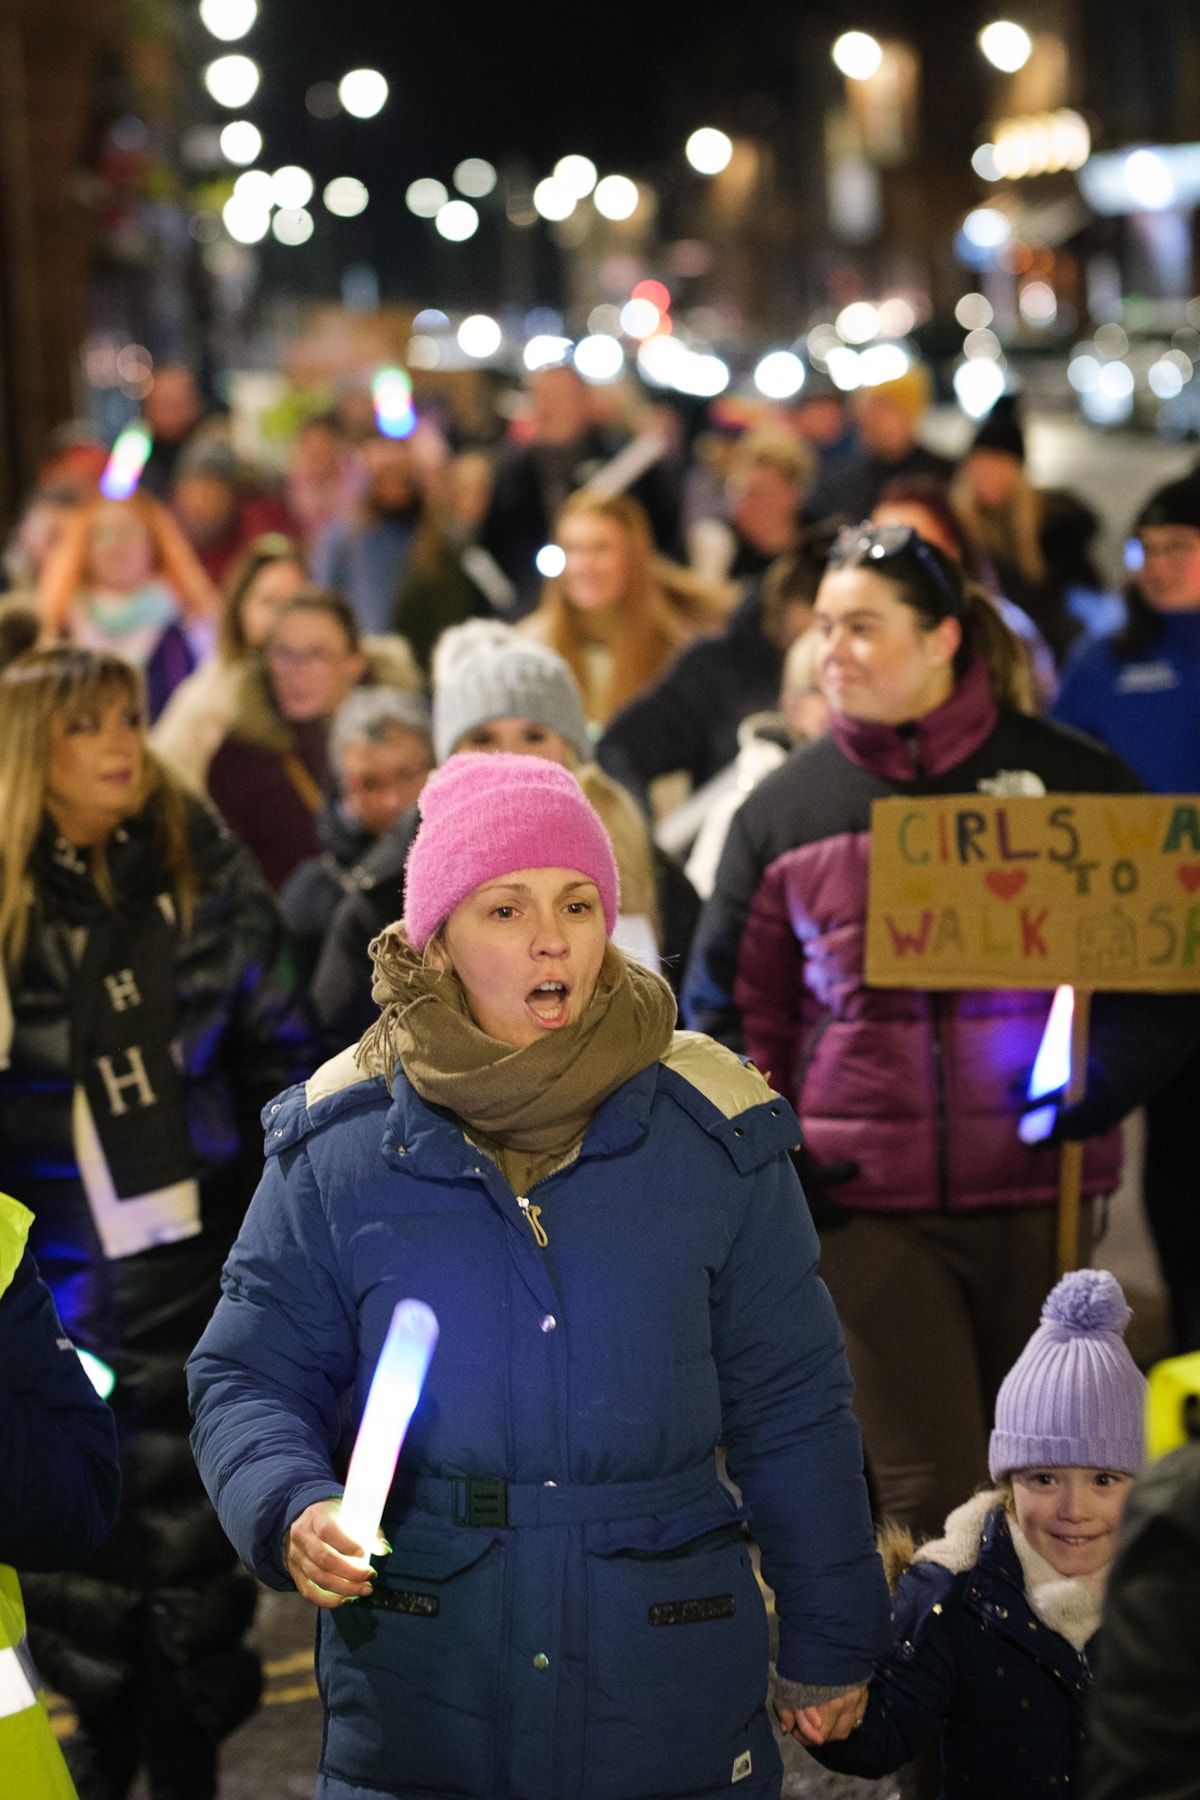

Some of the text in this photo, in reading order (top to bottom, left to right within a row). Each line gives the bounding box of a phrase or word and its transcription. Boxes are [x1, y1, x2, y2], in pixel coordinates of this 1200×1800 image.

[1065, 859, 1140, 896] TO
[884, 906, 1050, 959] WALK
[104, 968, 142, 1012] H
[96, 1045, 157, 1117] H
